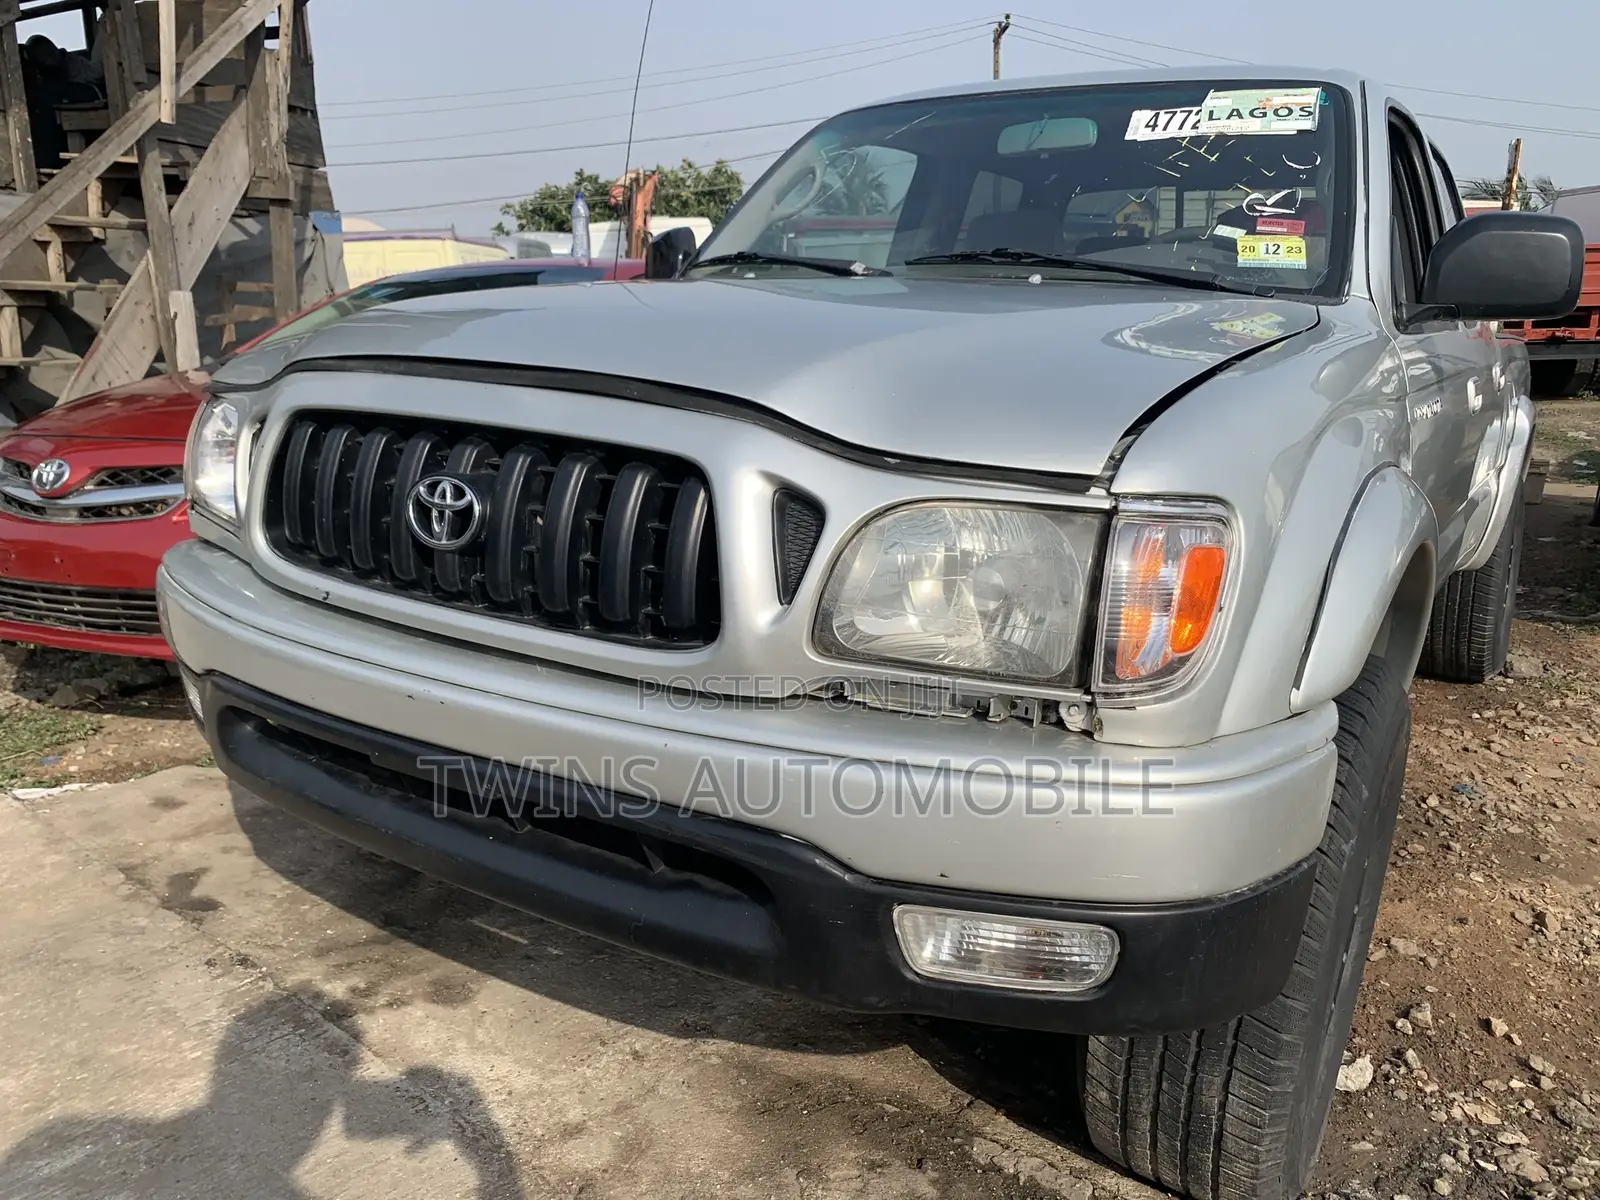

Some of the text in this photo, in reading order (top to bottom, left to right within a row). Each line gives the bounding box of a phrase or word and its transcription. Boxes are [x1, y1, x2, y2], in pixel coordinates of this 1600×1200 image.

[1208, 105, 1314, 121] LAGOS
[1241, 243, 1303, 255] 20 12 23
